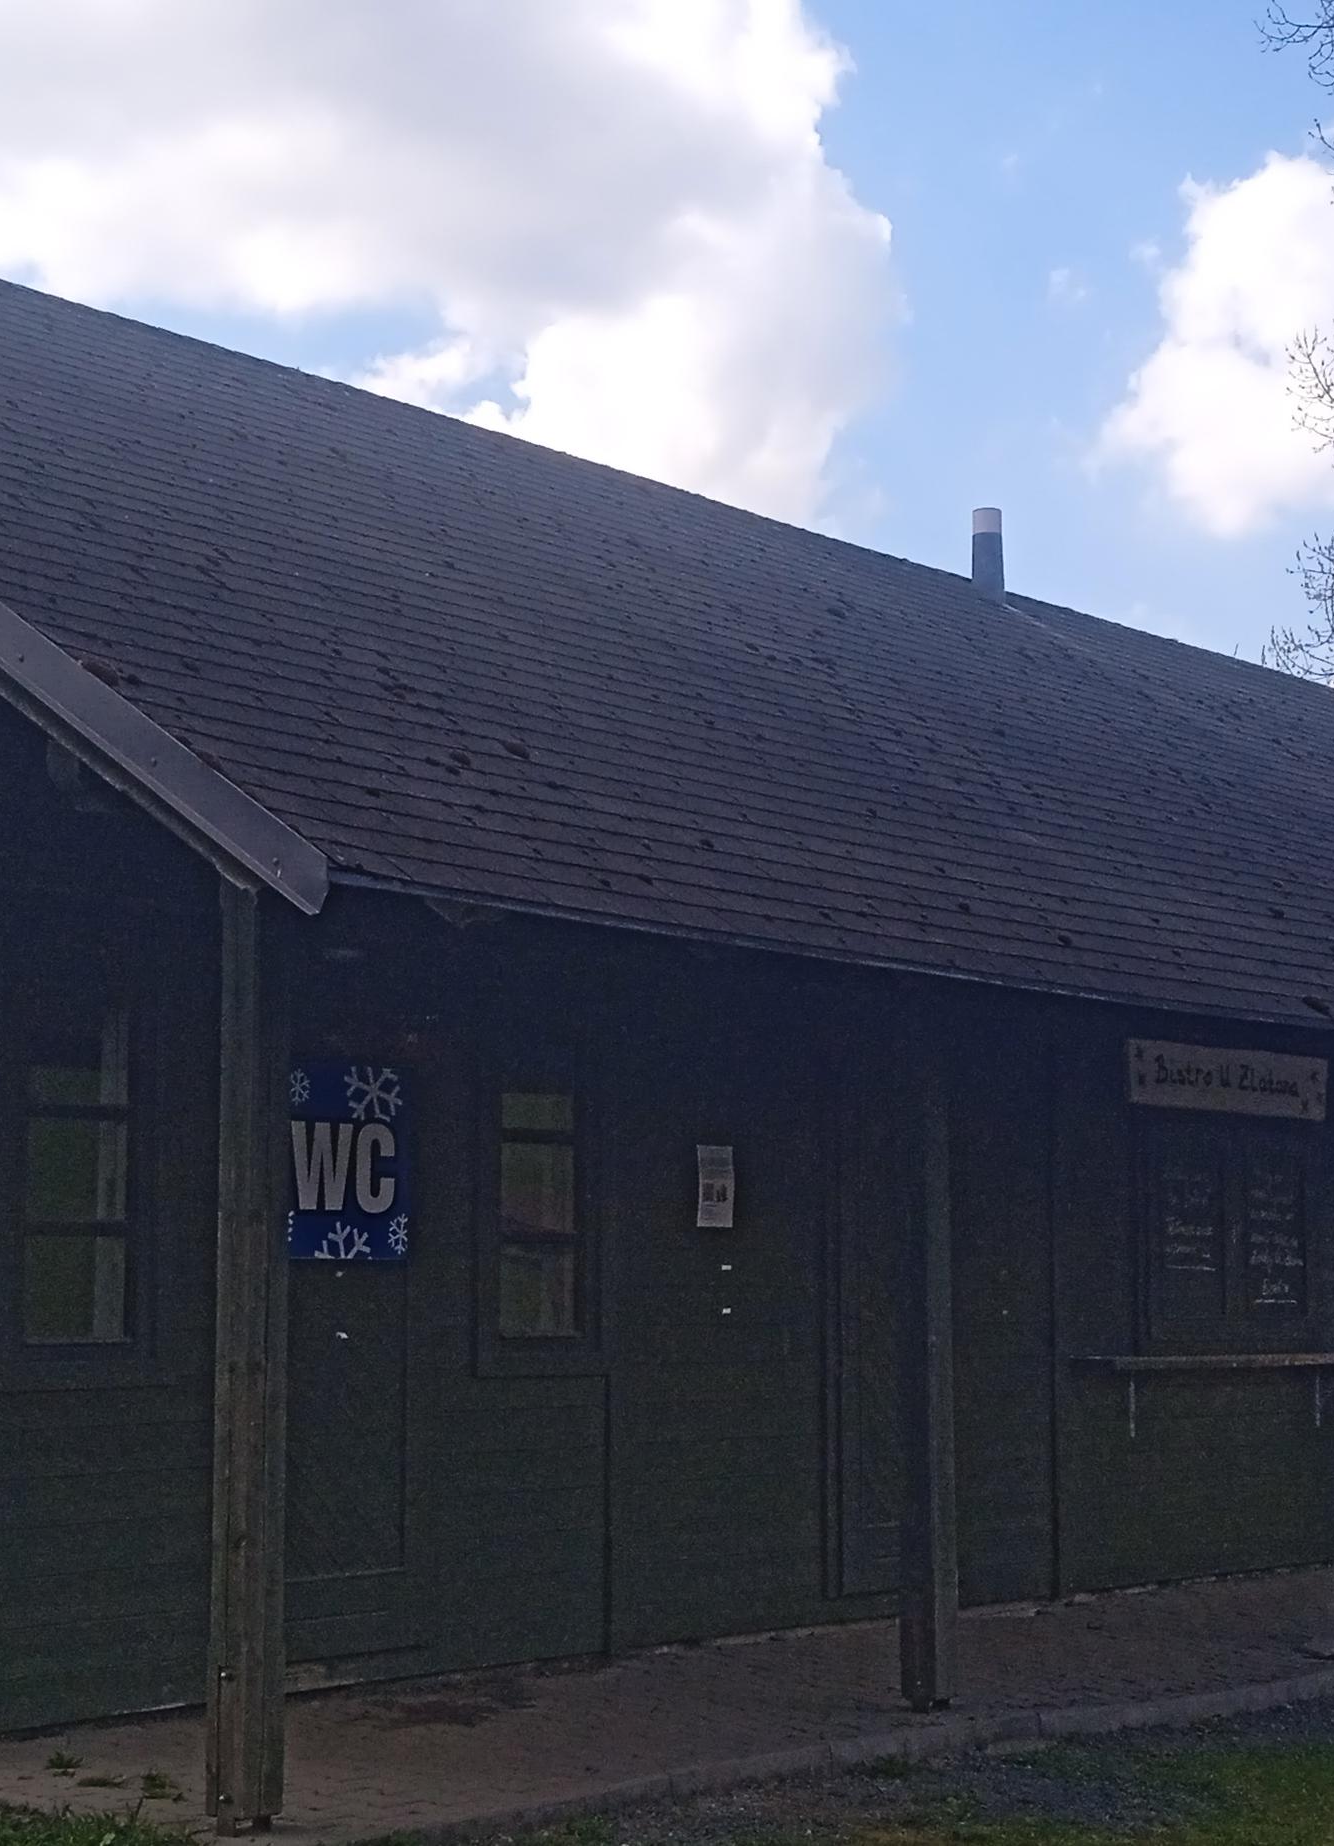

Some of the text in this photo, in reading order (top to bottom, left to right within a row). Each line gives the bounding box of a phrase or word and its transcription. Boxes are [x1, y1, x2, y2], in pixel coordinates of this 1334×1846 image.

[1154, 1053, 1212, 1088] Bistro
[1219, 1063, 1232, 1089] U
[291, 1120, 396, 1214] WC
